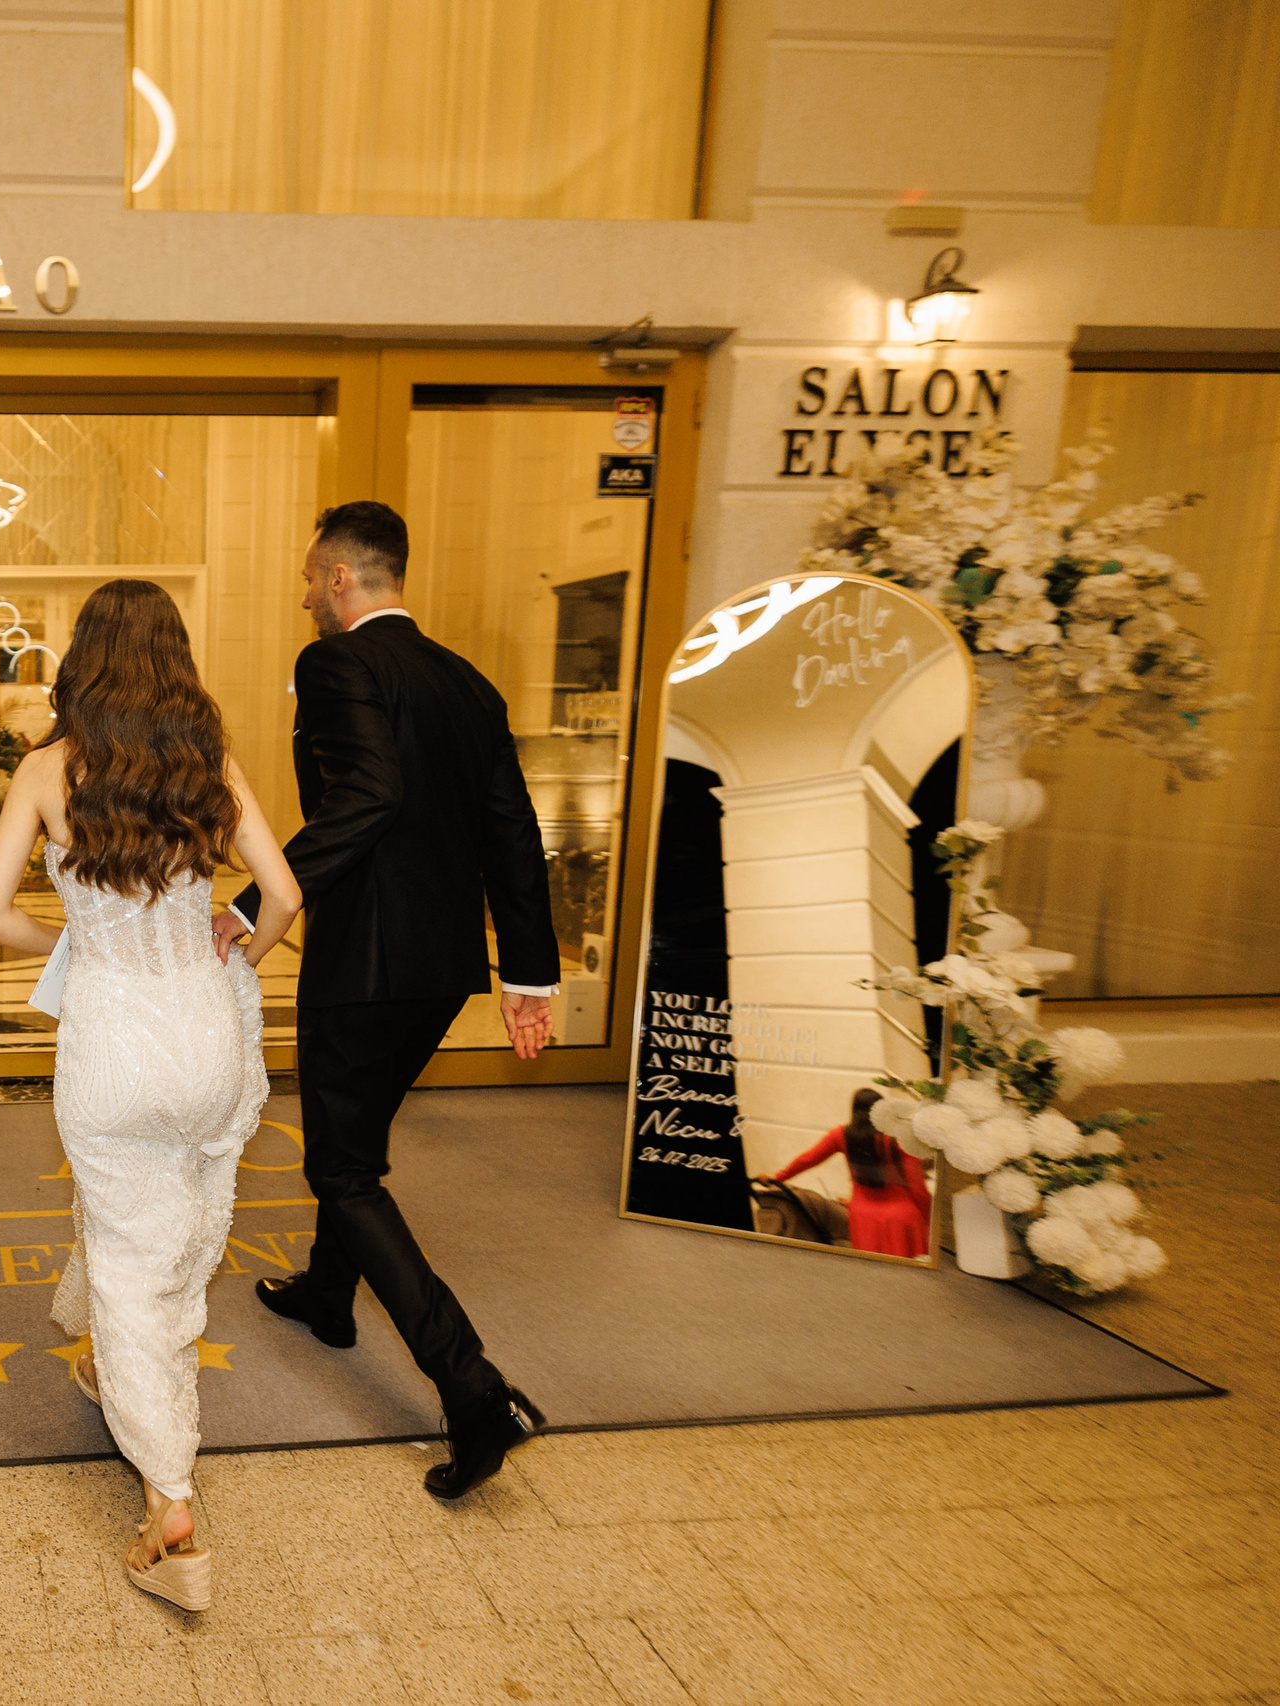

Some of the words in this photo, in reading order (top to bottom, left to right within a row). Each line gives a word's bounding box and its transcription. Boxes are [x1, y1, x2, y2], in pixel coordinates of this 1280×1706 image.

[796, 366, 1012, 418] SALON
[801, 589, 894, 646] Hello
[649, 991, 701, 1011] YOU
[706, 997, 769, 1018] LOOK
[646, 1053, 664, 1068] A
[649, 1031, 708, 1051] NOW
[709, 1038, 744, 1057] GO
[637, 1074, 746, 1107] Bianca
[638, 1107, 722, 1140] Nicu
[728, 1113, 750, 1138] &
